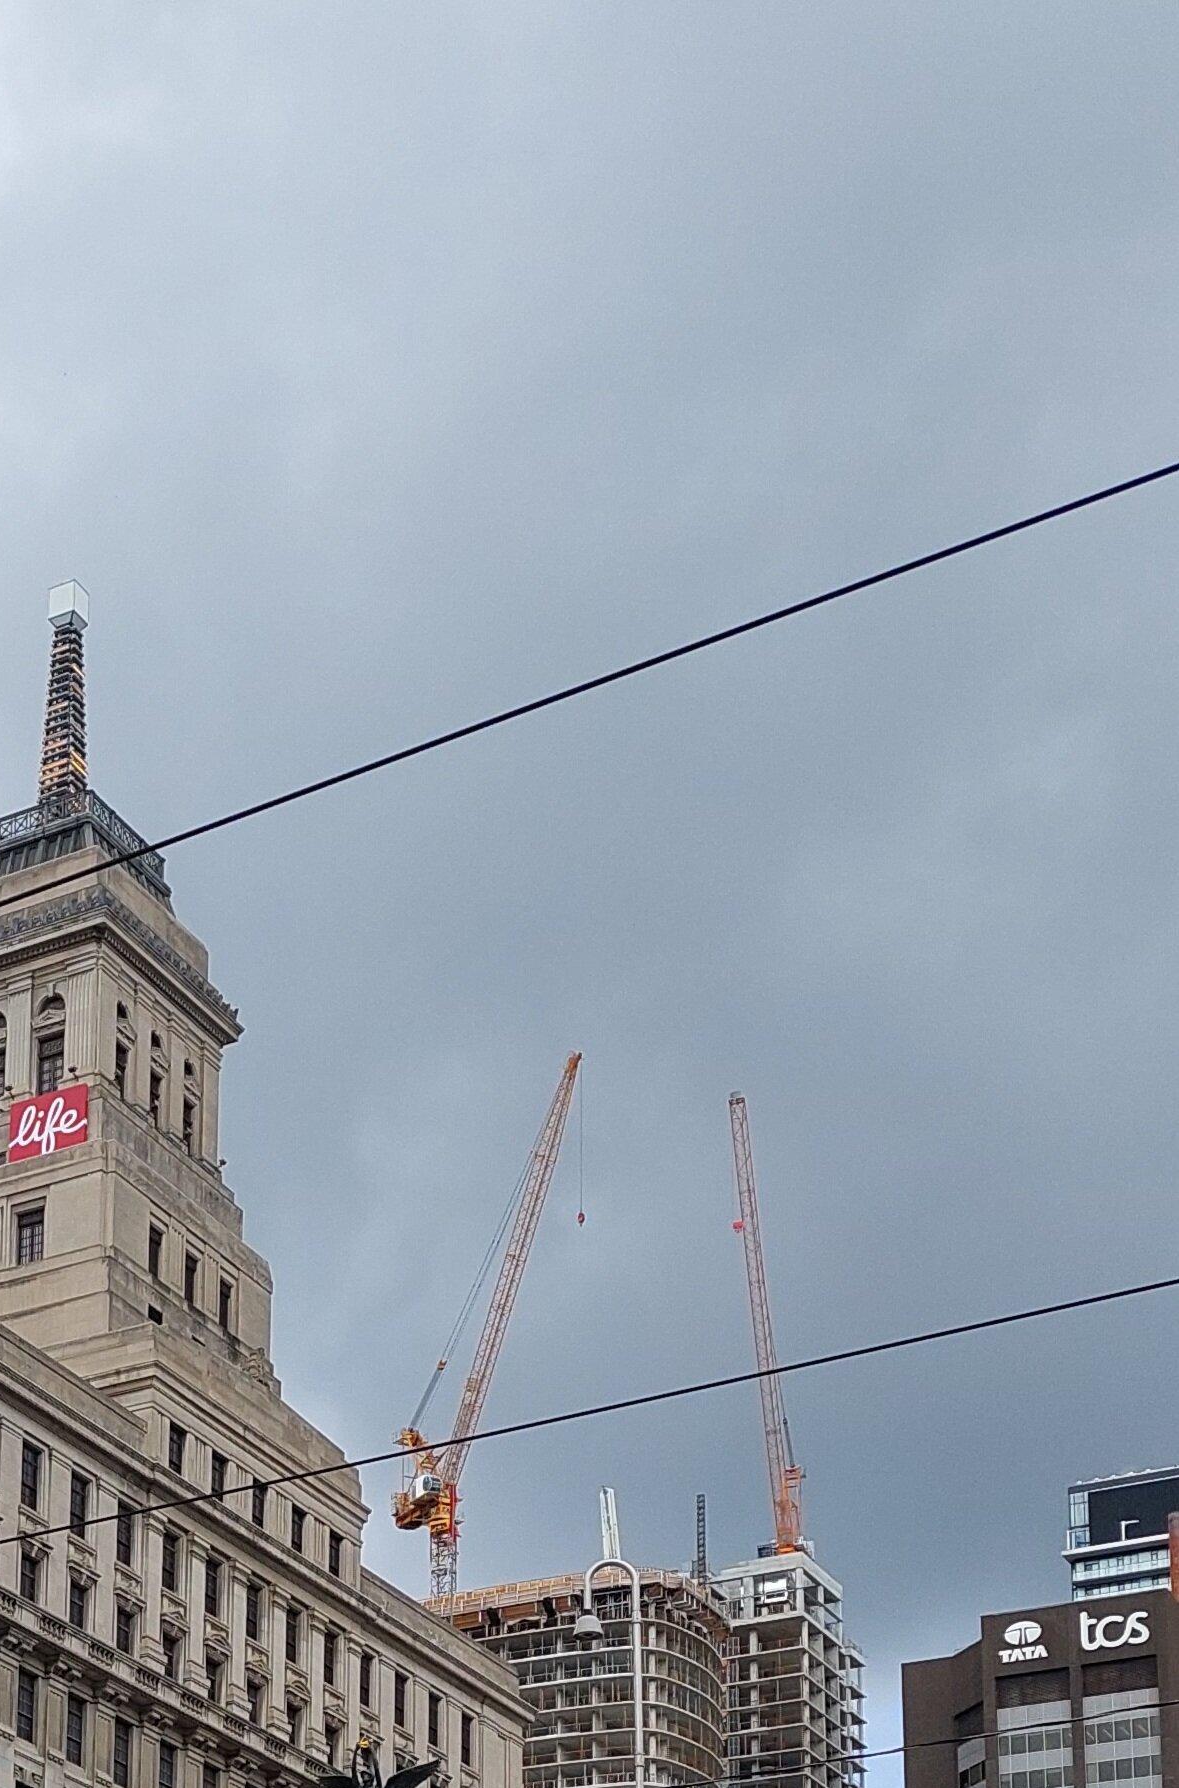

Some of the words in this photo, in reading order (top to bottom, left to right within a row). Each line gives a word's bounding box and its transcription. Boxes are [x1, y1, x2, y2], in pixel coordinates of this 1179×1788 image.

[9, 1097, 88, 1155] life
[1079, 1611, 1150, 1651] tcs
[998, 1645, 1049, 1664] TATA
